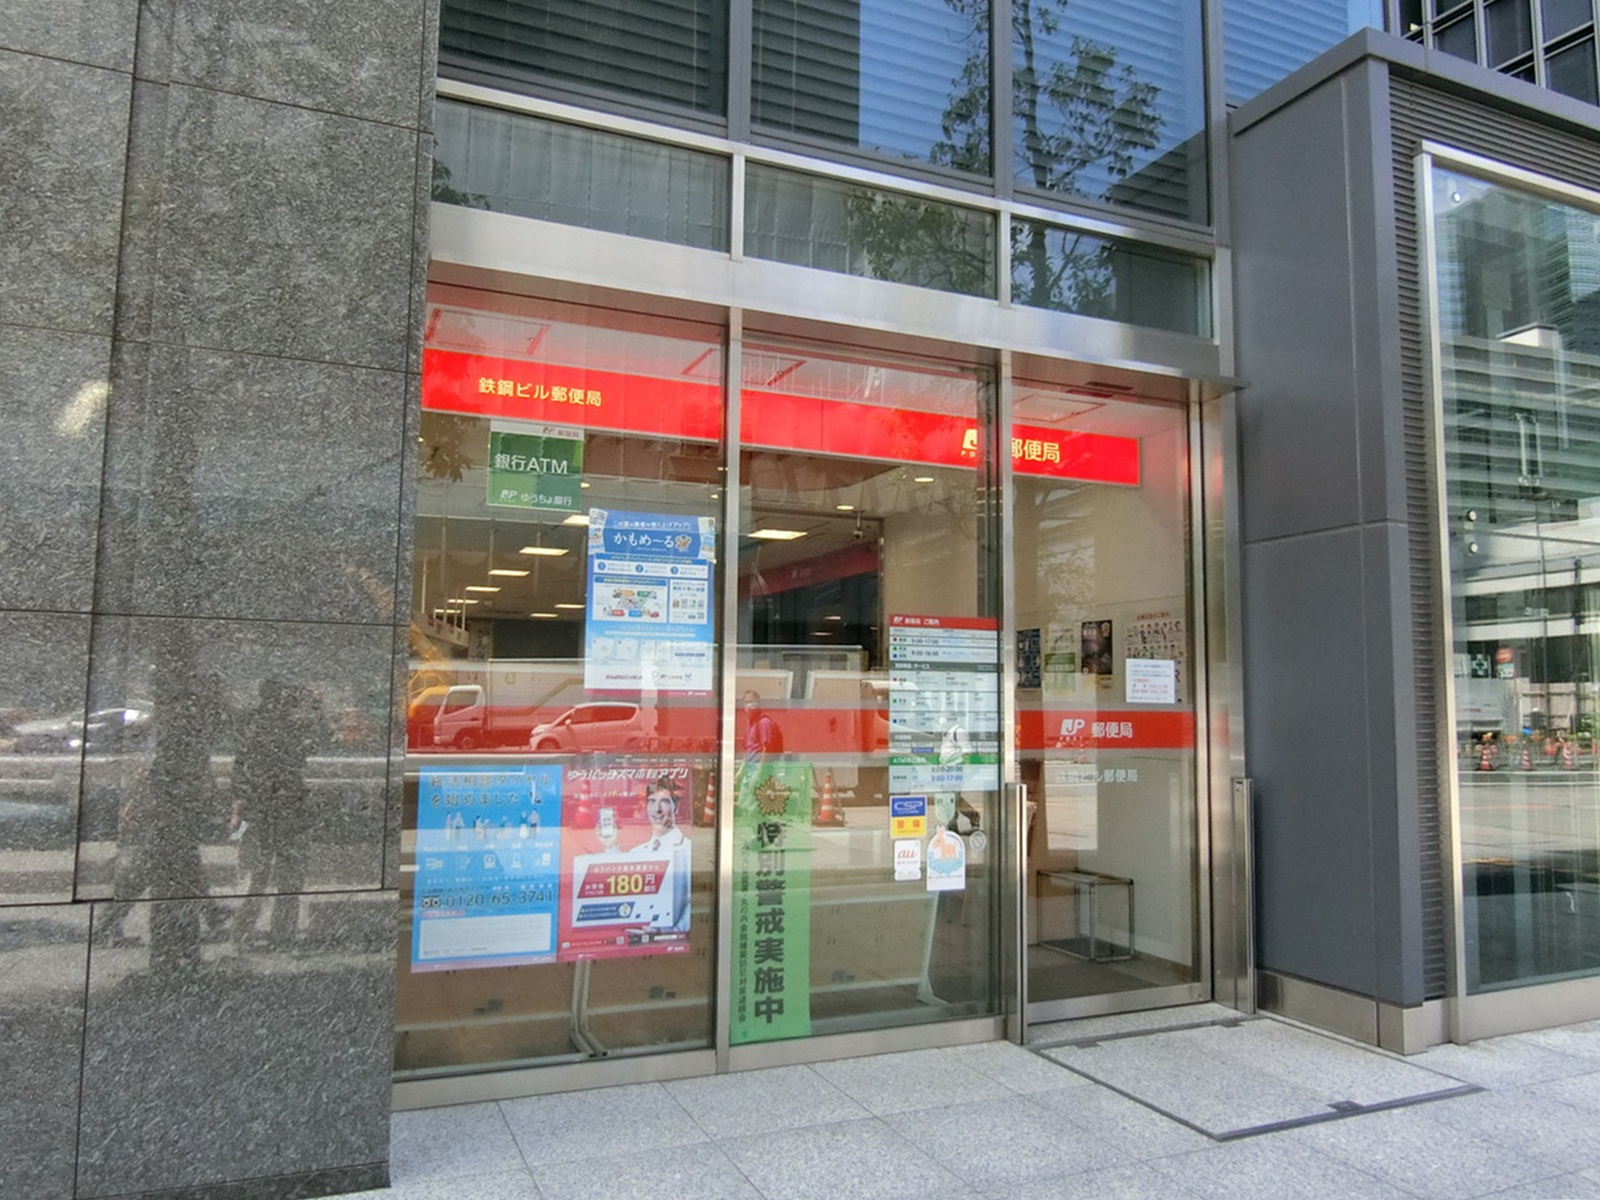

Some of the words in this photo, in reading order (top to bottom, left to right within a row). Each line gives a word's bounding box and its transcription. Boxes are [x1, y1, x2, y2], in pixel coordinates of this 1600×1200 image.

[478, 377, 602, 407] 鉄鋼ビル郵便局
[495, 453, 568, 474] 銀行ATM
[520, 492, 573, 506] ゆうちょ銀行
[1061, 718, 1085, 736] JP
[1091, 721, 1134, 739] 郵便局
[567, 768, 689, 781] ゆうパックスマホ割アプリ
[431, 793, 519, 807] を始めました
[893, 800, 924, 811] CSP
[898, 849, 918, 859] au
[606, 874, 644, 895] 180
[644, 873, 656, 885] 円
